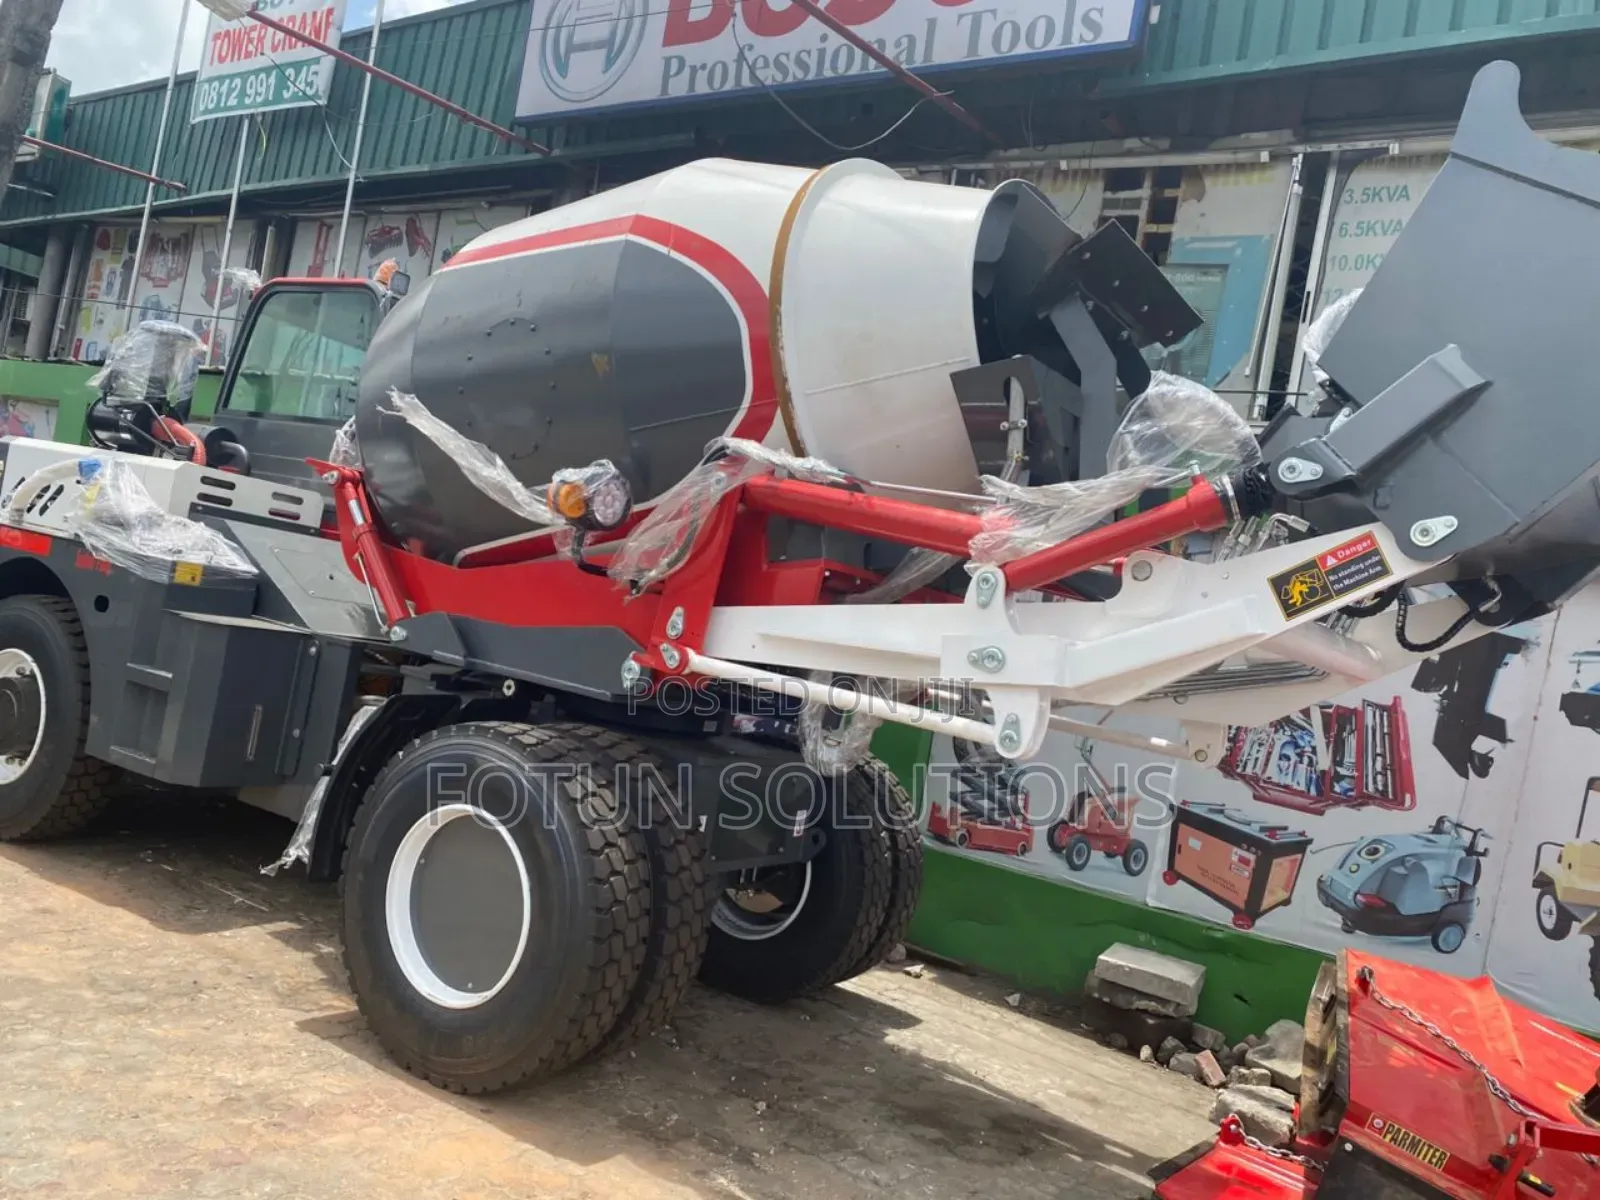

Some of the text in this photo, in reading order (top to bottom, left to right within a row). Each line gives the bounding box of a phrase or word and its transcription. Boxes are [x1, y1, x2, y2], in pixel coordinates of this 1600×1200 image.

[210, 22, 268, 66] TOWER
[658, 18, 938, 97] Professional
[956, 0, 1104, 59] Tools
[200, 77, 241, 111] 0812
[244, 68, 277, 104] 991
[1344, 185, 1410, 205] 3.5KVA
[1336, 539, 1372, 559] Danger
[1383, 1122, 1447, 1170] PARMITER
